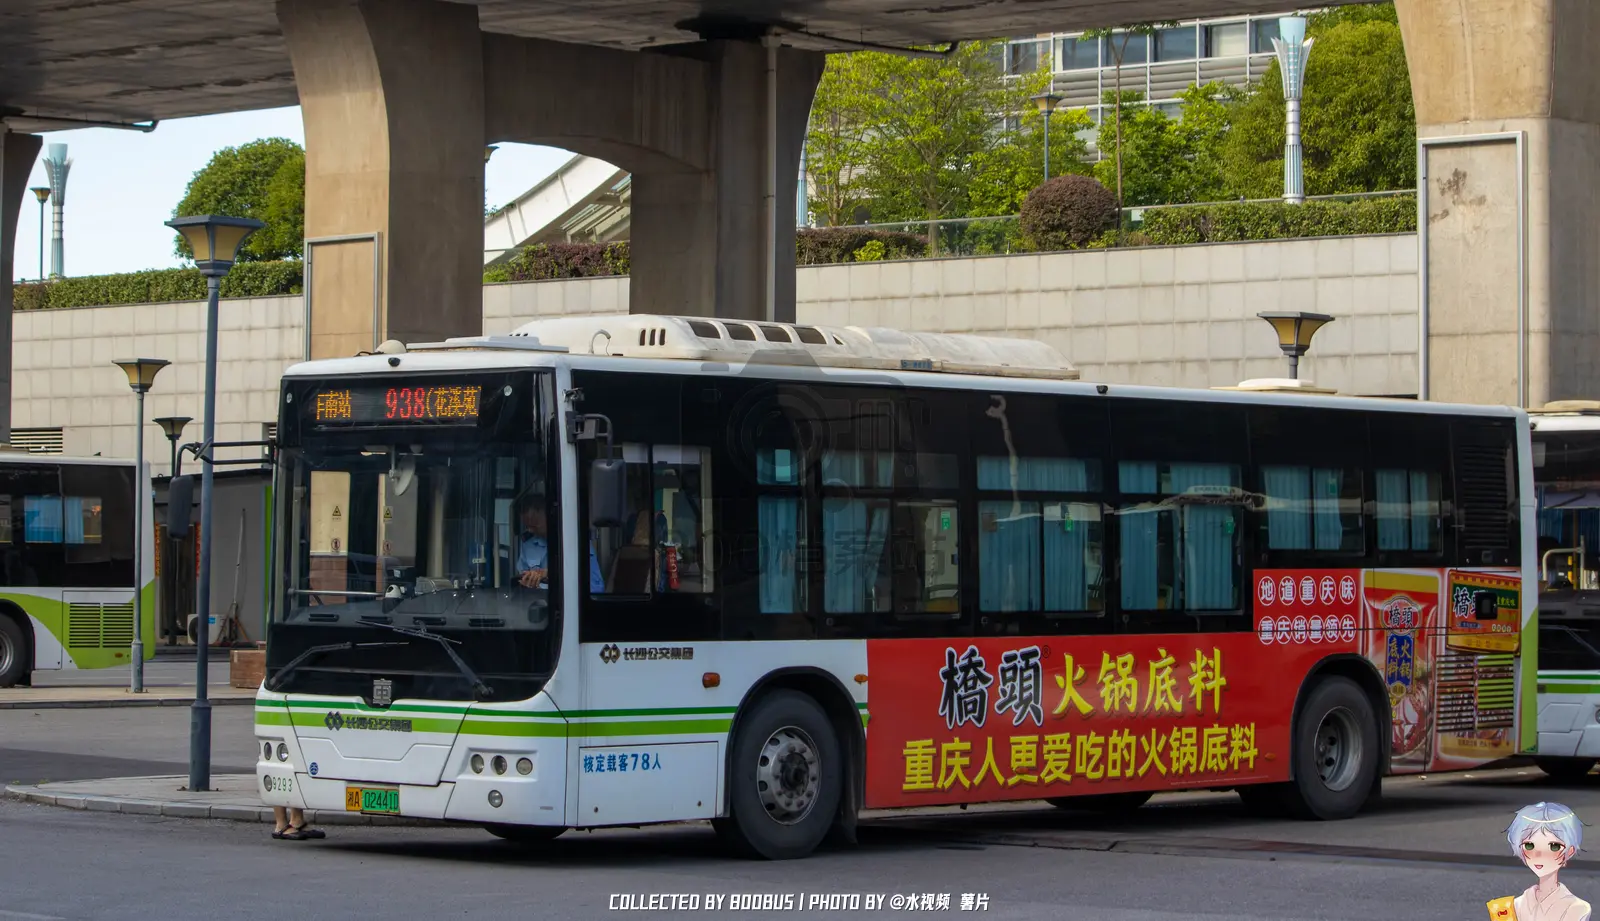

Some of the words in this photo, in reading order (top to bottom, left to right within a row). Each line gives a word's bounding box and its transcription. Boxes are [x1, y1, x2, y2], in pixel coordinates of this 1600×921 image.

[1258, 577, 1356, 604] 地道重庆味
[1388, 604, 1414, 628] 橋頭
[1258, 616, 1356, 643] 重庆销量领先
[622, 647, 694, 661] 长沙公交集团
[344, 717, 413, 733] 长沙公交集团
[583, 753, 662, 773] 核定载客78人
[902, 722, 1259, 793] 重庆人更爱吃的火锅底料
[272, 778, 293, 793] 9293
